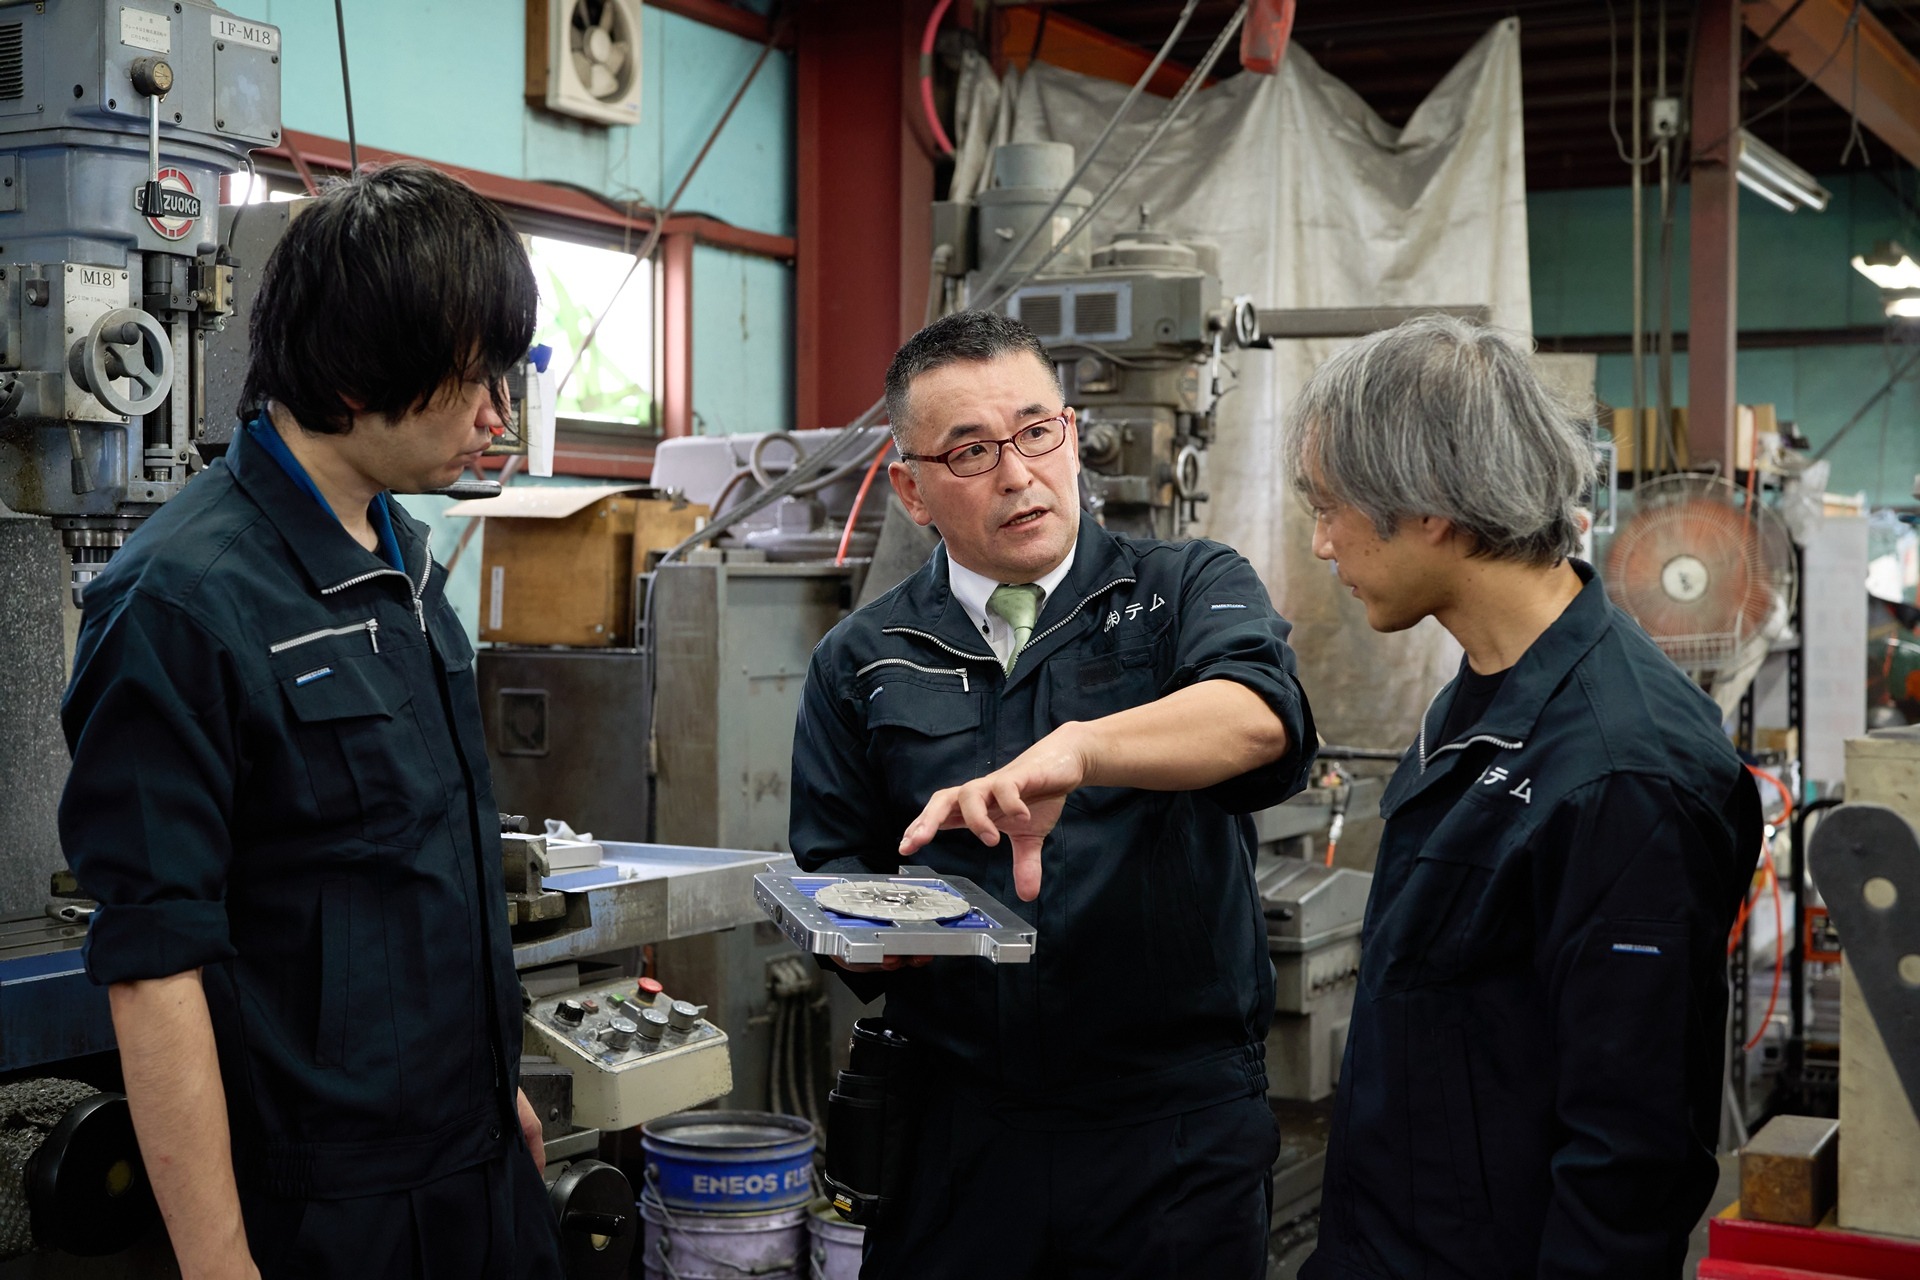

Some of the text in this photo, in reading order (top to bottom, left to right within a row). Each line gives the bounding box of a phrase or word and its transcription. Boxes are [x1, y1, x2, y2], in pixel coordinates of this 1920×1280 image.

[219, 20, 271, 45] 1F-M18
[83, 270, 112, 287] M18
[692, 1174, 778, 1195] ENEOS
